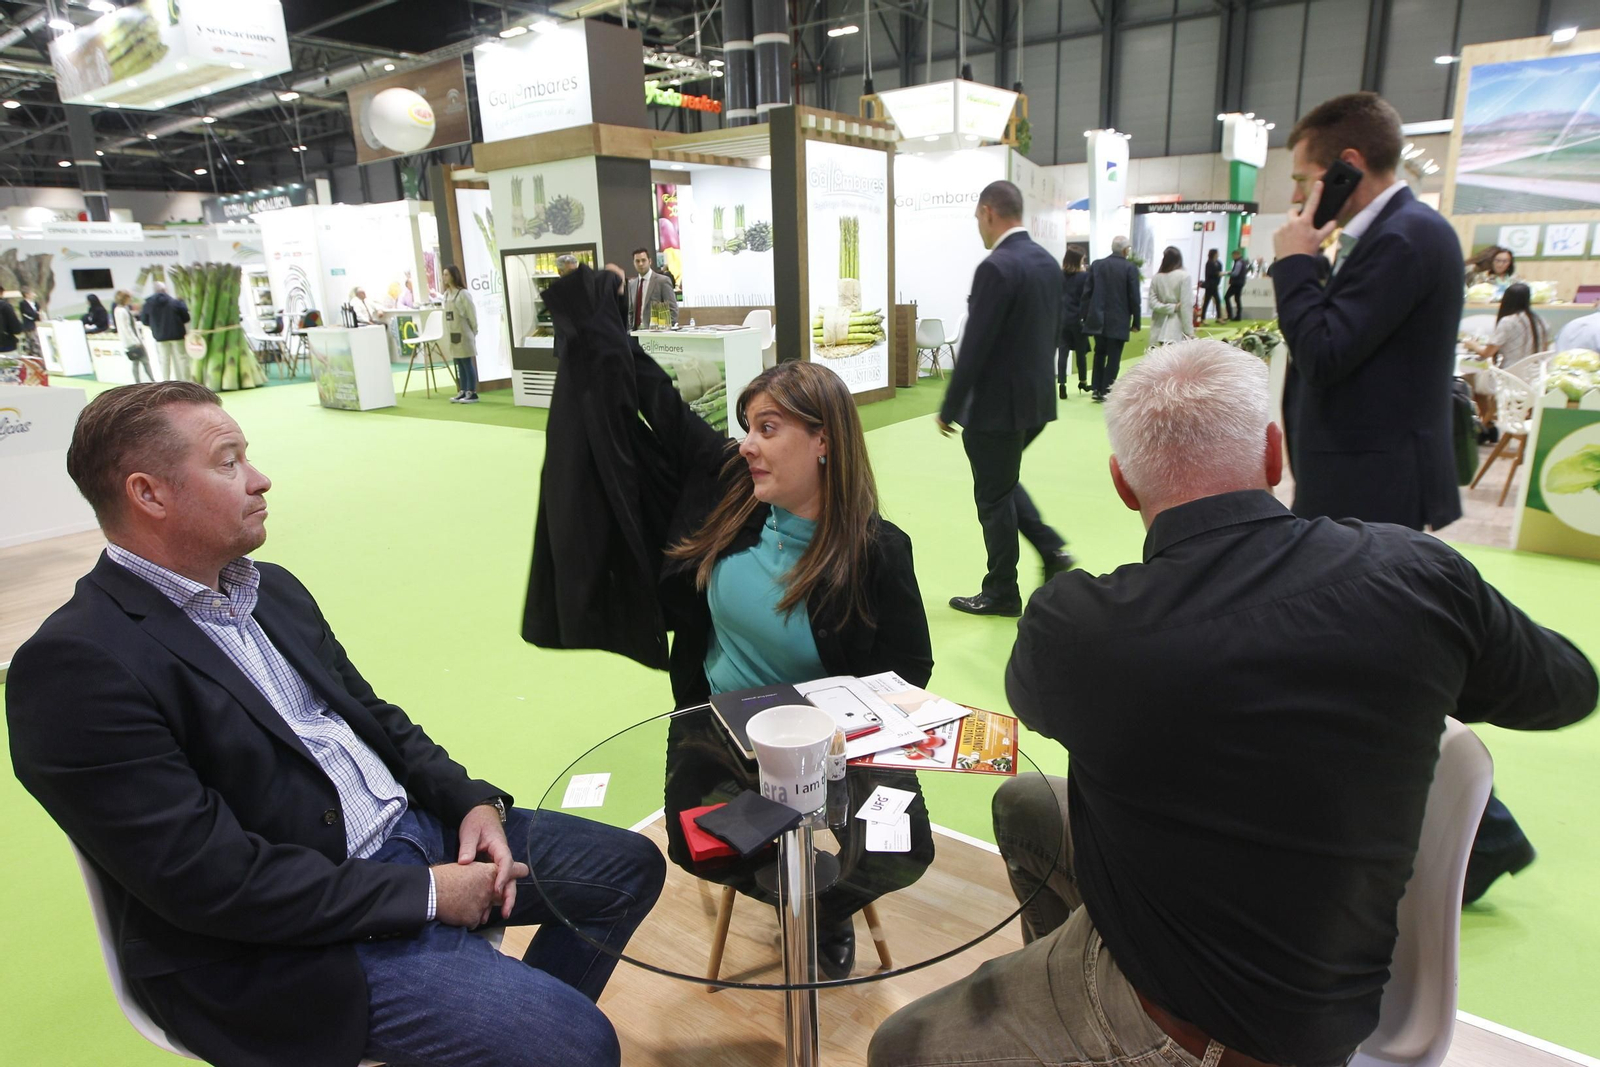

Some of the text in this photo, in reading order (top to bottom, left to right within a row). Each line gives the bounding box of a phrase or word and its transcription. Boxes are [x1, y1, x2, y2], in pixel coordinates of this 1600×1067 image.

[489, 76, 578, 110] Gallombares
[809, 158, 885, 196] Gallombares
[895, 190, 979, 211] Gallombare
[1148, 202, 1245, 212] www.huertadelmolino.es
[642, 339, 684, 354] Gallombares
[795, 783, 799, 795] I
[802, 780, 820, 794] am
[870, 794, 889, 811] UFG
